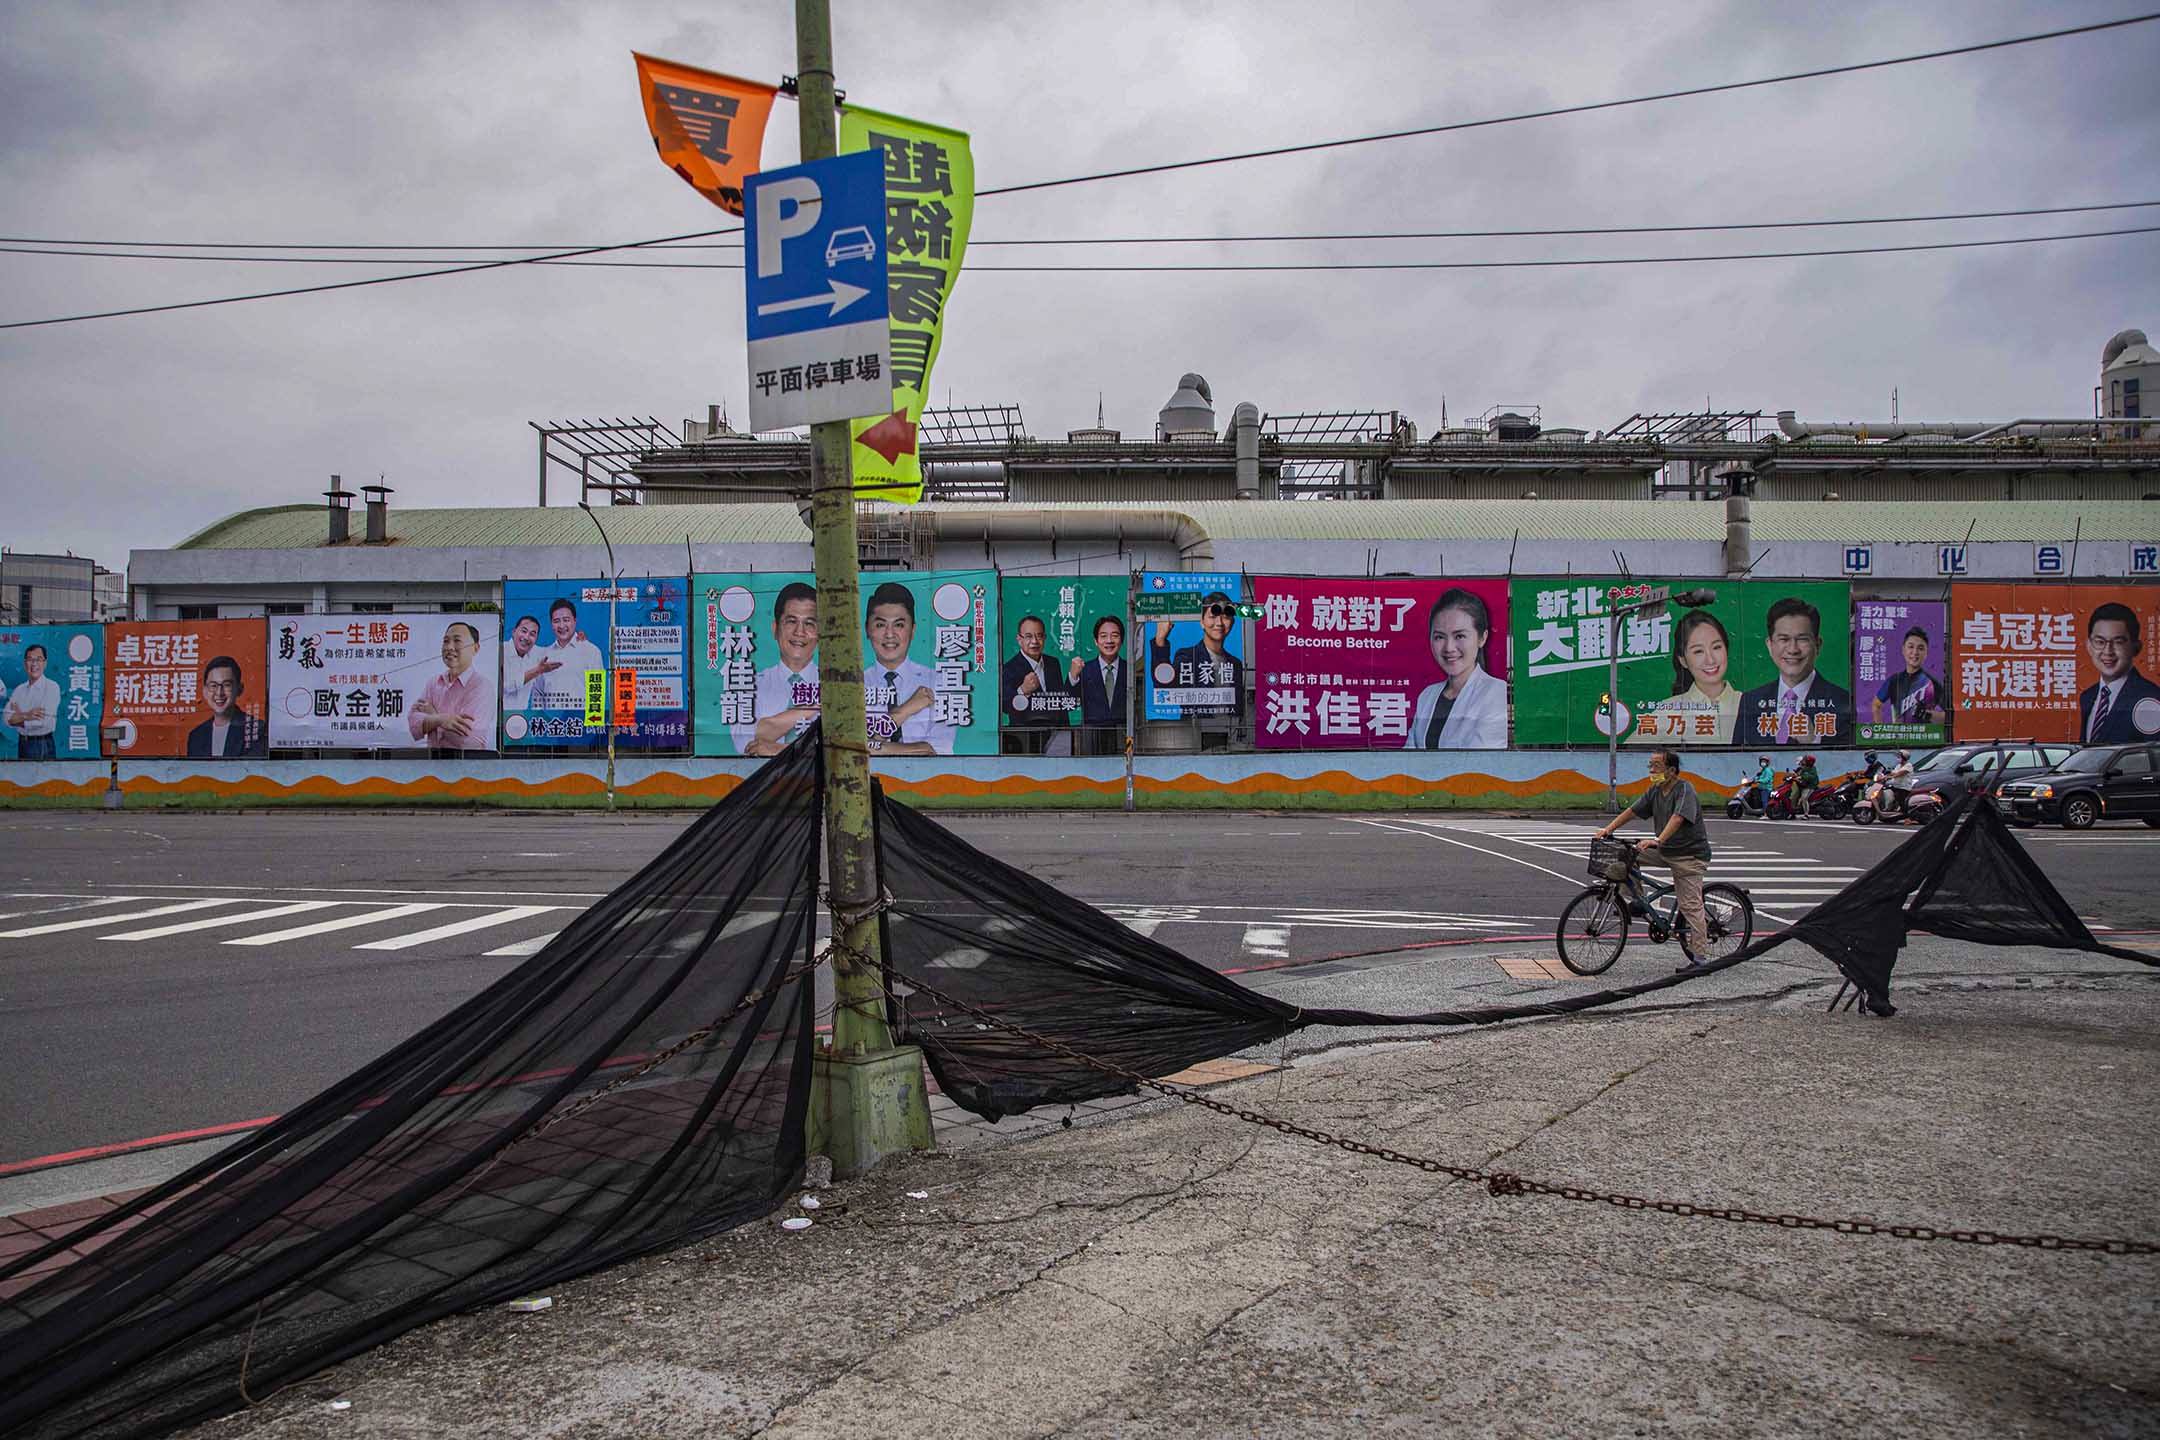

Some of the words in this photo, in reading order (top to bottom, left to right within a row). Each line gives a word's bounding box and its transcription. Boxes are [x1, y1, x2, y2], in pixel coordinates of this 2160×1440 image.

[756, 176, 822, 279] P
[755, 353, 882, 397] 平面停車場
[1059, 586, 1075, 652] 信賴台灣
[1263, 594, 1299, 630] 做
[1311, 594, 1417, 633] 就對了
[1535, 586, 1604, 620] 新北
[1860, 606, 1883, 617] 活力
[279, 624, 325, 670] 勇氣
[325, 622, 410, 645] 一生懸命
[1287, 635, 1342, 649] Become
[1346, 635, 1390, 650] Better
[1527, 612, 1672, 665] 大翻新
[1960, 611, 2077, 652] 卓冠廷
[114, 634, 199, 665] 卓冠廷
[324, 648, 406, 659] 為你打造希望城市
[1859, 636, 1874, 681] 廖宜琨
[114, 672, 199, 705] 新選擇
[329, 673, 391, 685] 城市規劃達人
[719, 626, 756, 725] 林佳龍
[933, 624, 972, 726] 廖宜琨
[1179, 661, 1235, 685] 呂家愷
[1280, 673, 1344, 686] 新北市議員
[1960, 658, 2077, 699] 新選擇
[67, 665, 91, 751] 黃永昌
[313, 689, 404, 718] 歐金獅
[1031, 697, 1076, 711] 陳世榮
[1173, 691, 1234, 704] 行動的力量
[1265, 689, 1411, 737] 洪佳君
[331, 721, 384, 731] 市議員候選人
[530, 717, 585, 737] 林金結
[1637, 714, 1716, 737] 高乃芸
[1756, 713, 1837, 737] 林佳龍
